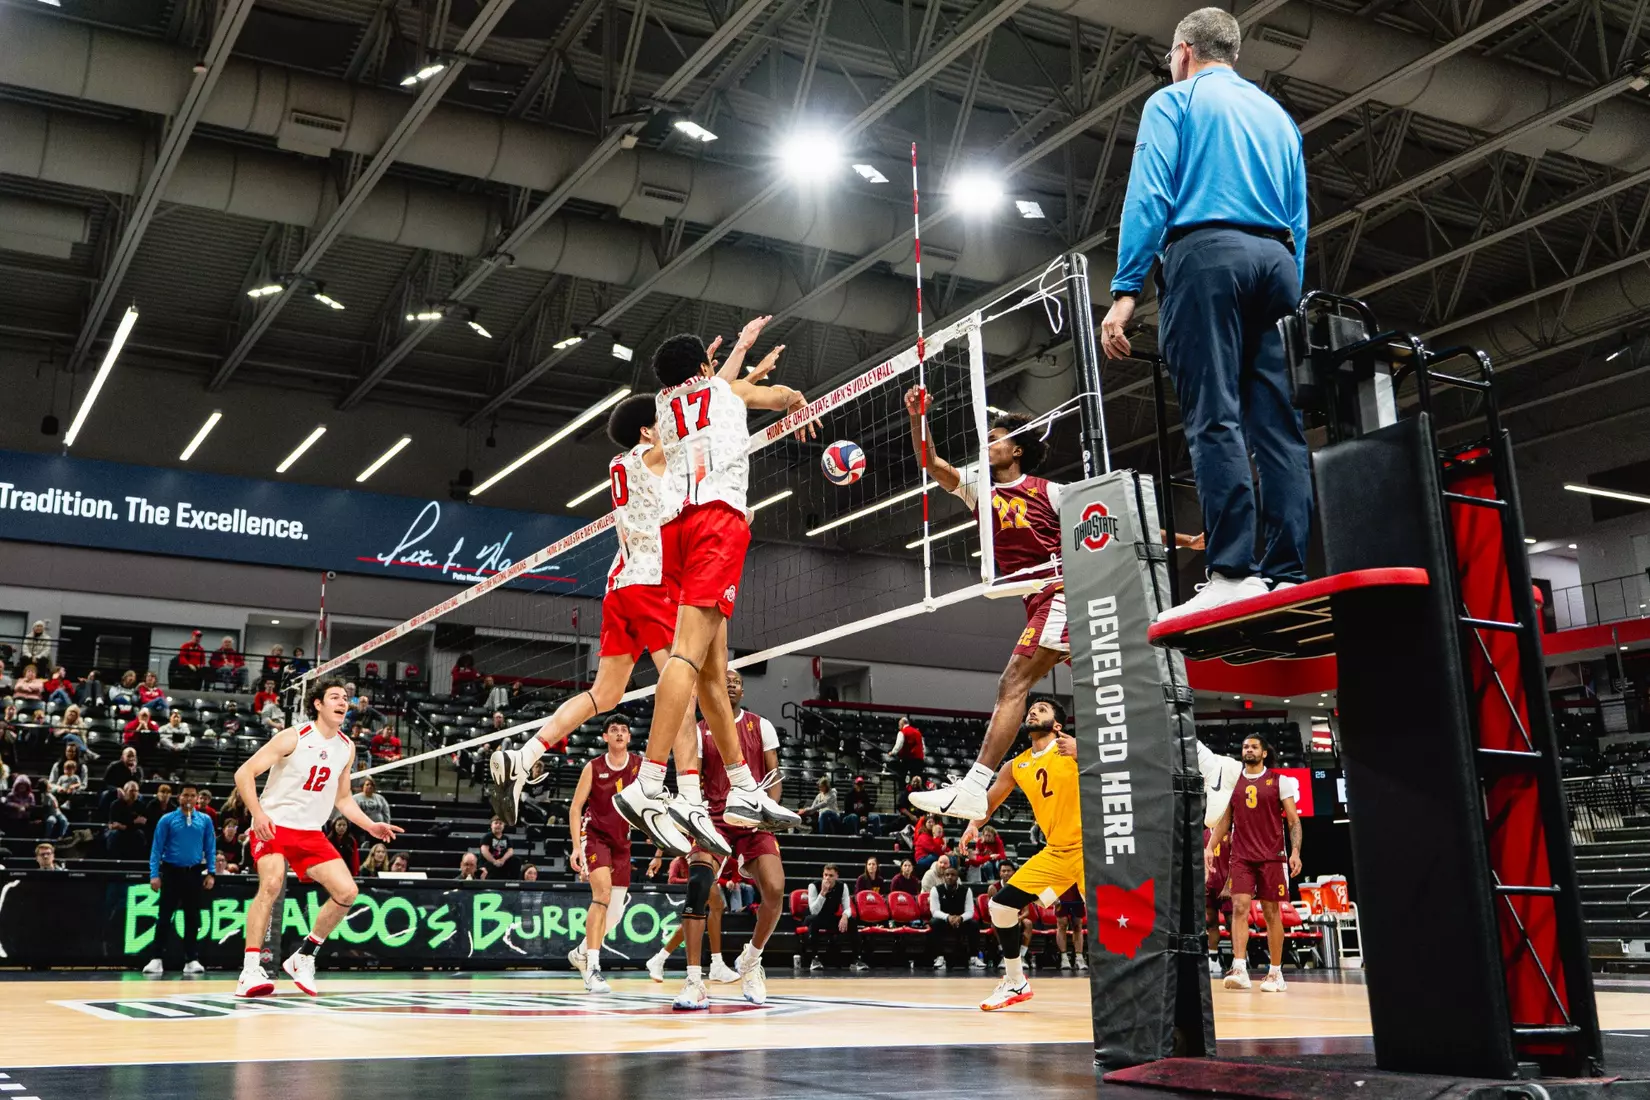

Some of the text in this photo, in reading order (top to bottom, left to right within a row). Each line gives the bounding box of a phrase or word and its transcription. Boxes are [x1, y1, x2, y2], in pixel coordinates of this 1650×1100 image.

[670, 387, 711, 440] 17
[766, 361, 895, 440] HOME OF OHIO STATE MEN'S VOLLEYBALL
[0, 482, 308, 540] Tradition. The Excellence.
[992, 494, 1031, 530] 22
[1074, 515, 1120, 551] OHIO STATE
[1087, 595, 1136, 865] DEVELOPED HERE.
[302, 765, 331, 792] 12
[1035, 768, 1054, 799] 2
[1245, 785, 1258, 809] 3
[1278, 885, 1285, 897] 3
